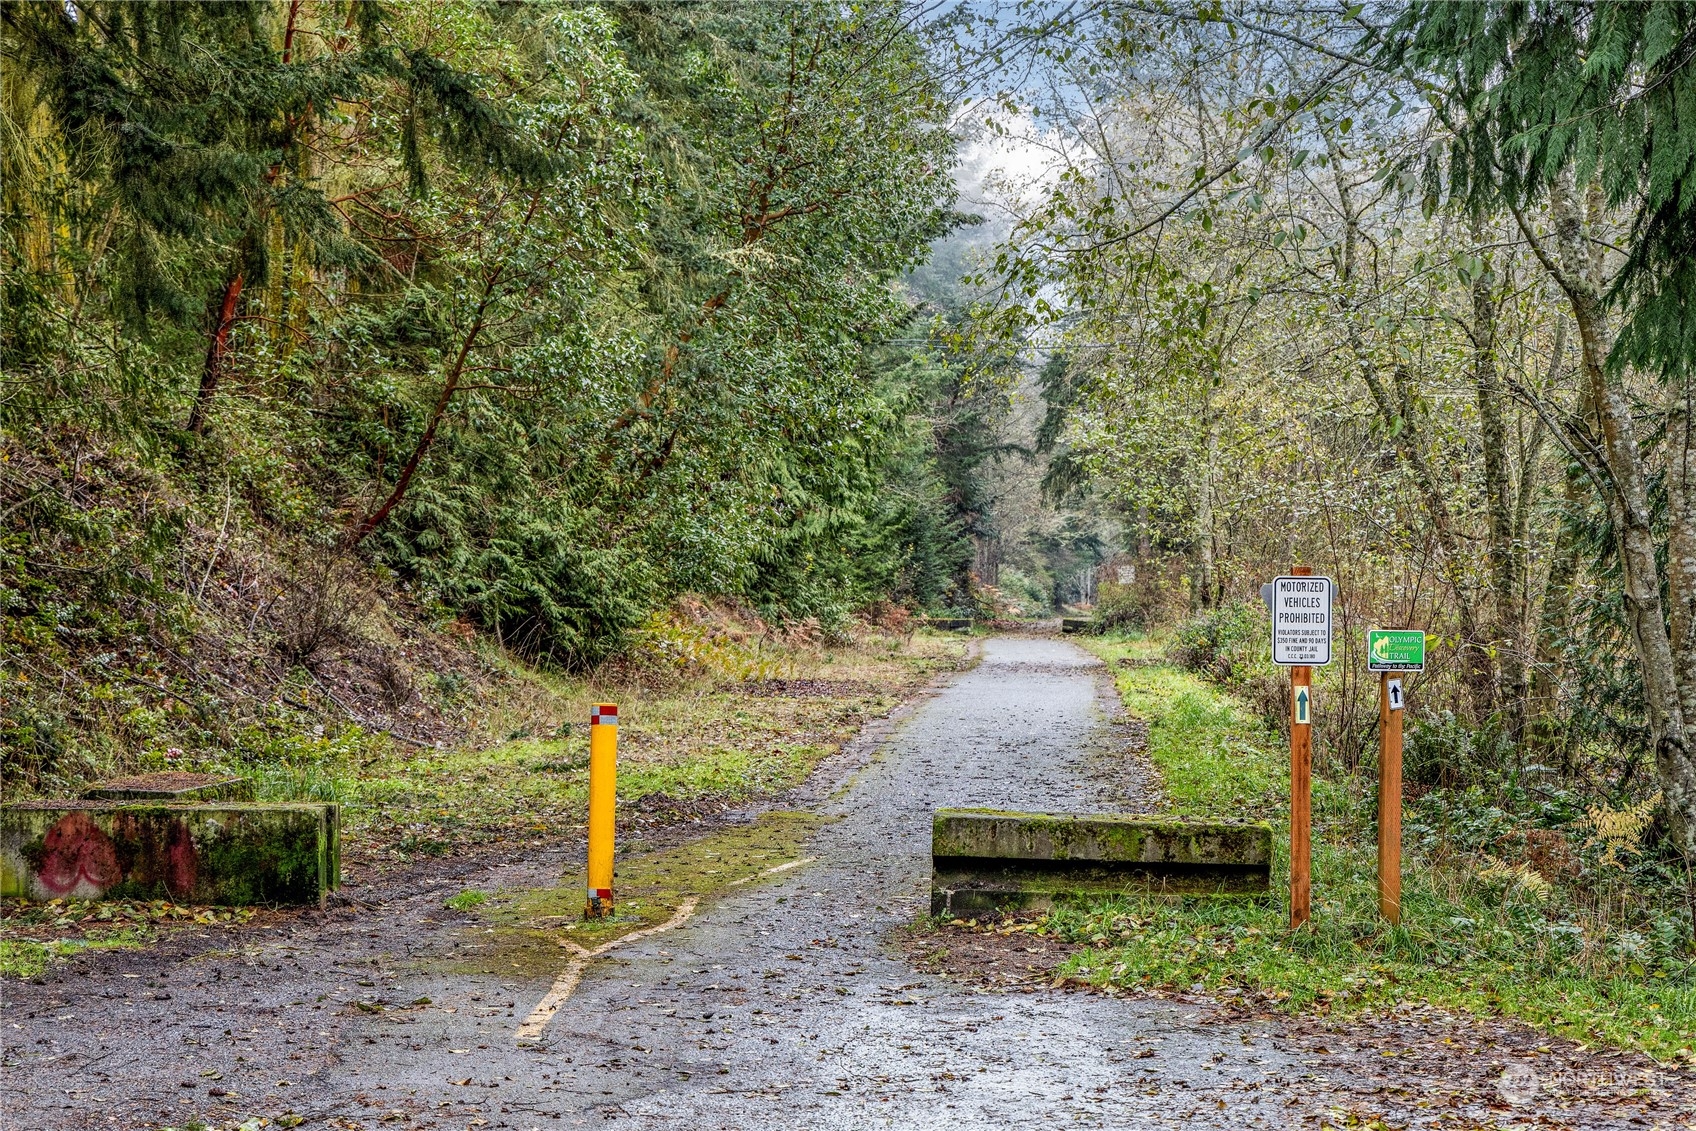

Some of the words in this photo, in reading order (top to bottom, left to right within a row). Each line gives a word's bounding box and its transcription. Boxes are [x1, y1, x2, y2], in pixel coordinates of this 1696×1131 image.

[1280, 582, 1324, 592] MOTORIZED
[1284, 597, 1321, 608] VEHICLES
[1279, 612, 1325, 623] PROHIBITED
[1390, 644, 1419, 654] Discovery
